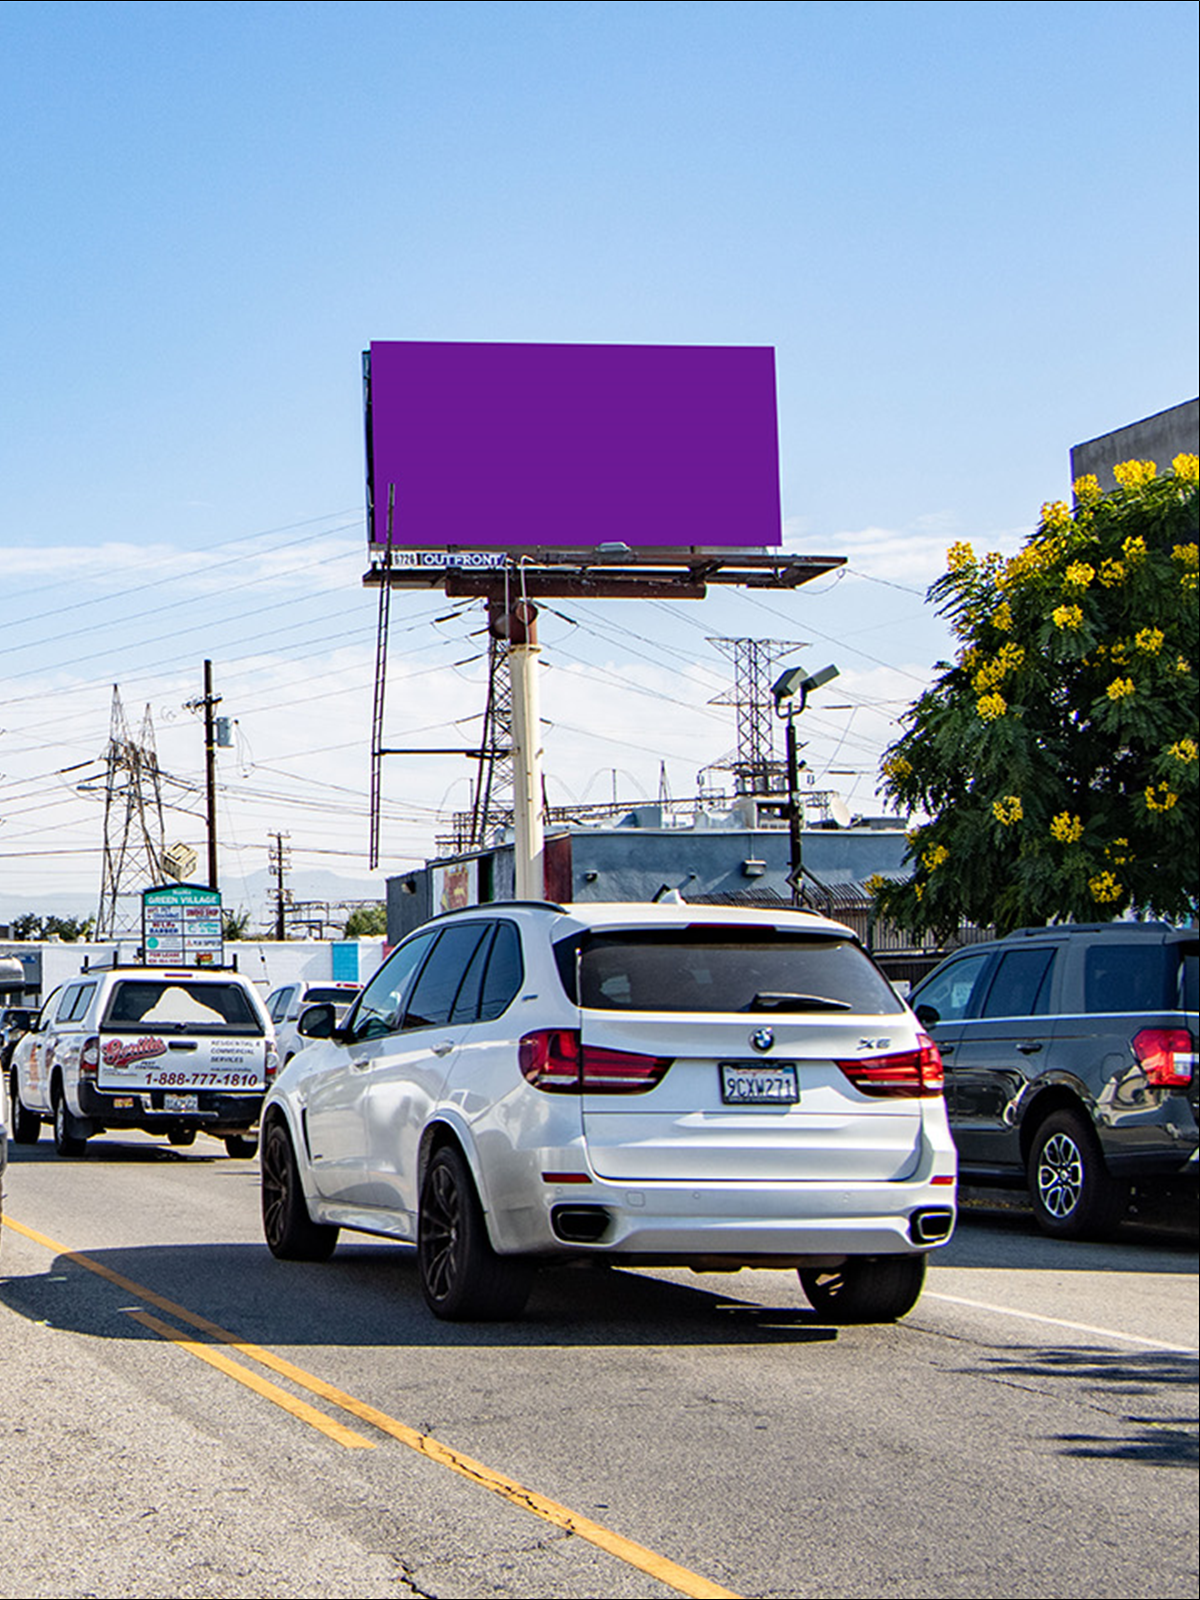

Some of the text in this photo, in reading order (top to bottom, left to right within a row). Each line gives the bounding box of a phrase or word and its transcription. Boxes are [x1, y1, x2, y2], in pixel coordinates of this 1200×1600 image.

[148, 895, 217, 903] GREEN VILLAGE
[210, 1047, 254, 1055] COMMERCIAL
[144, 1072, 259, 1087] 1-888-777-1810
[726, 1077, 792, 1098] 9CXW271
